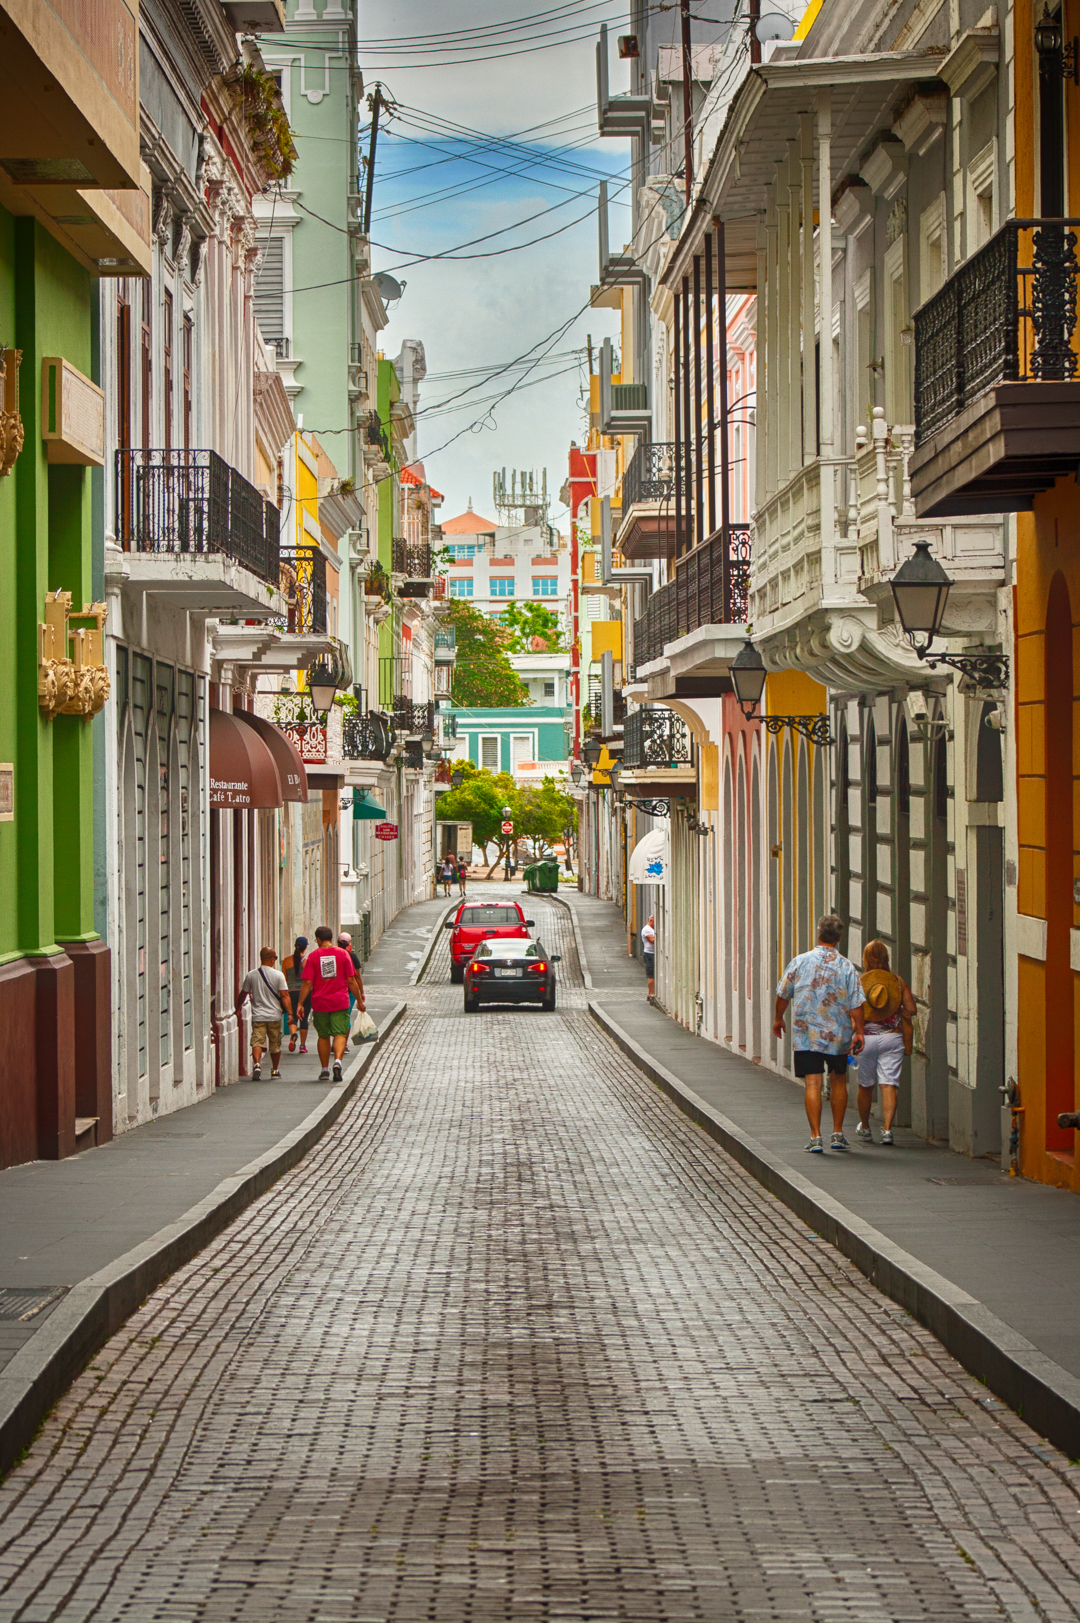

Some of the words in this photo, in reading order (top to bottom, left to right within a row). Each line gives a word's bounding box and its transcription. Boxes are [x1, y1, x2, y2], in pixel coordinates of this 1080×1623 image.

[210, 778, 248, 790] Restaurante
[287, 774, 294, 785] El
[209, 790, 225, 802] Café
